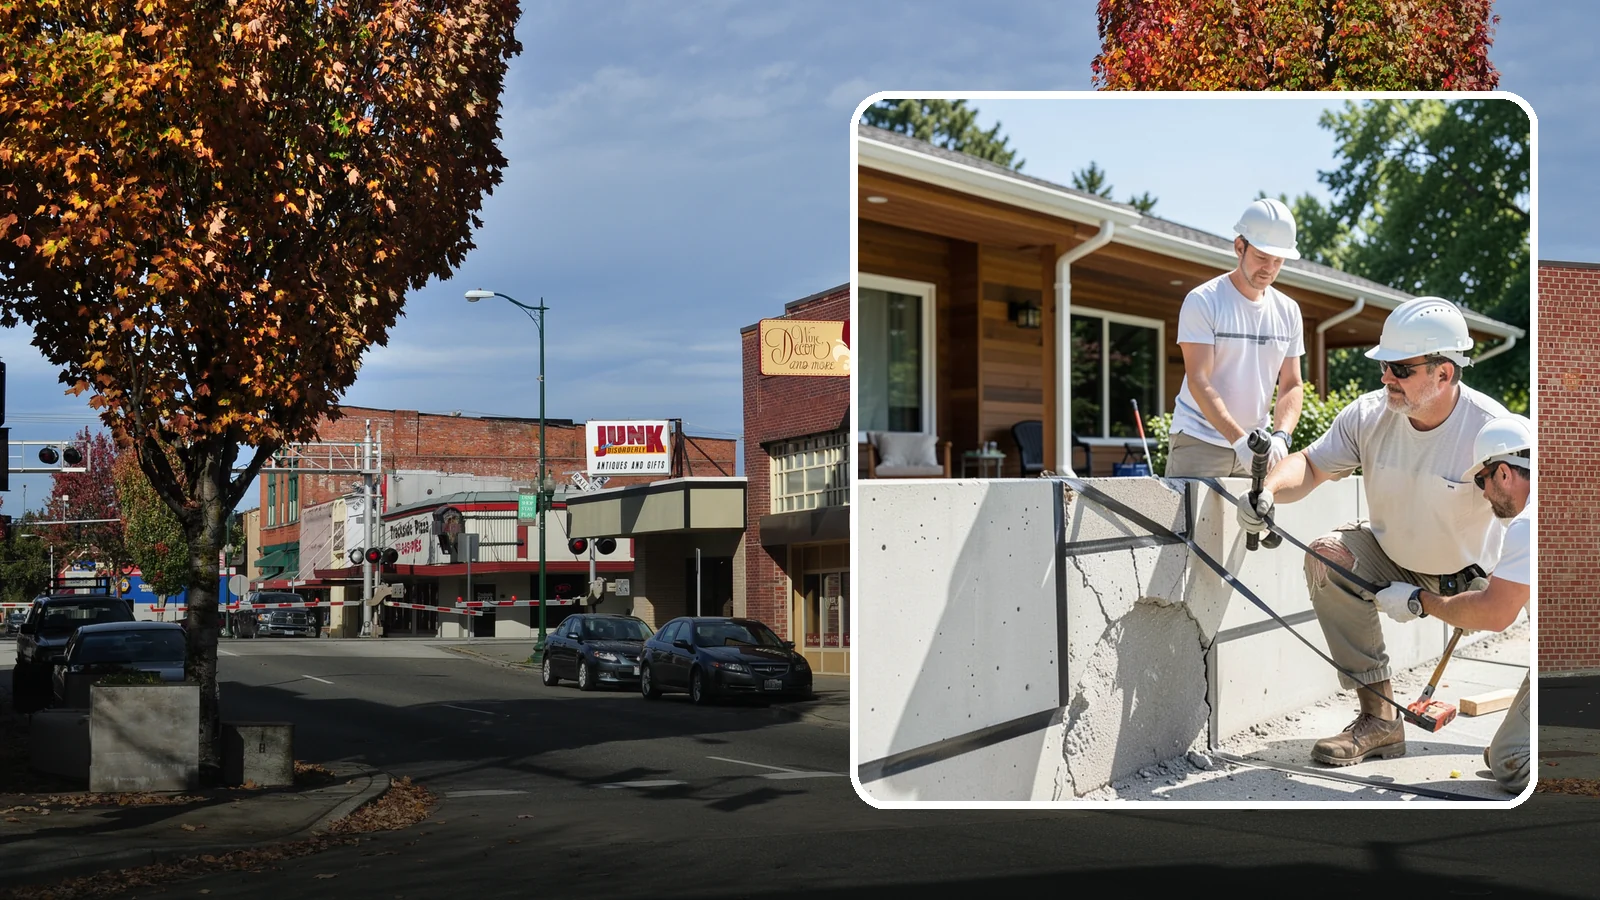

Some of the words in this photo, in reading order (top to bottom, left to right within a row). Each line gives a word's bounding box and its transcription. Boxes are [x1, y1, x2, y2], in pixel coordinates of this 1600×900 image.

[595, 425, 665, 457] JUNK
[607, 446, 646, 454] DISORDERLY
[597, 461, 628, 470] ANTIQUES
[631, 461, 644, 470] AND
[646, 460, 665, 469] GIFTS
[390, 521, 413, 539] Trackside
[414, 519, 429, 535] Pizza
